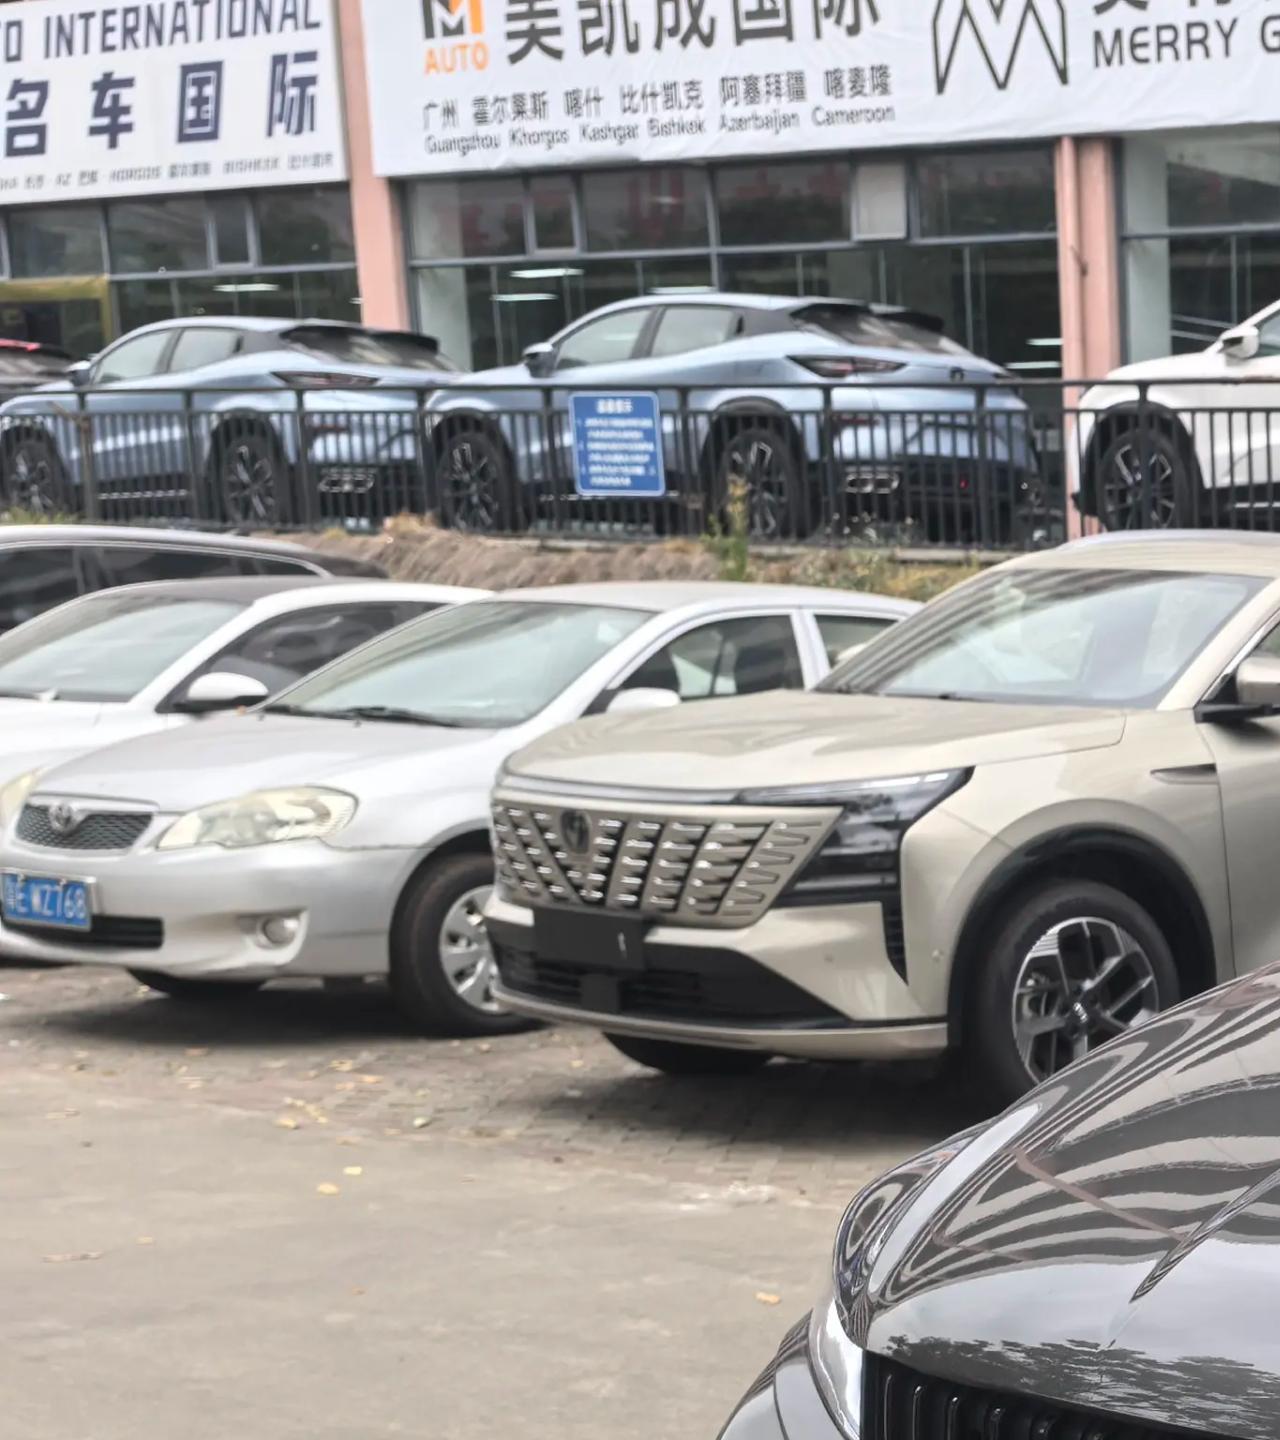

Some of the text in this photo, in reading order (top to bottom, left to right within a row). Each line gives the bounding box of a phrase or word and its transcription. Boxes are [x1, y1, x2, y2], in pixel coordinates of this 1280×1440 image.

[0, 0, 321, 62] O INTERNATIONAL
[1093, 17, 1239, 68] MERRY
[424, 41, 489, 75] AUTO
[5, 51, 320, 157] 名车国际
[423, 98, 461, 130] 广州
[619, 77, 704, 114] 比什凯克
[424, 131, 501, 157] Guangzhou
[811, 105, 896, 127] Cameroon
